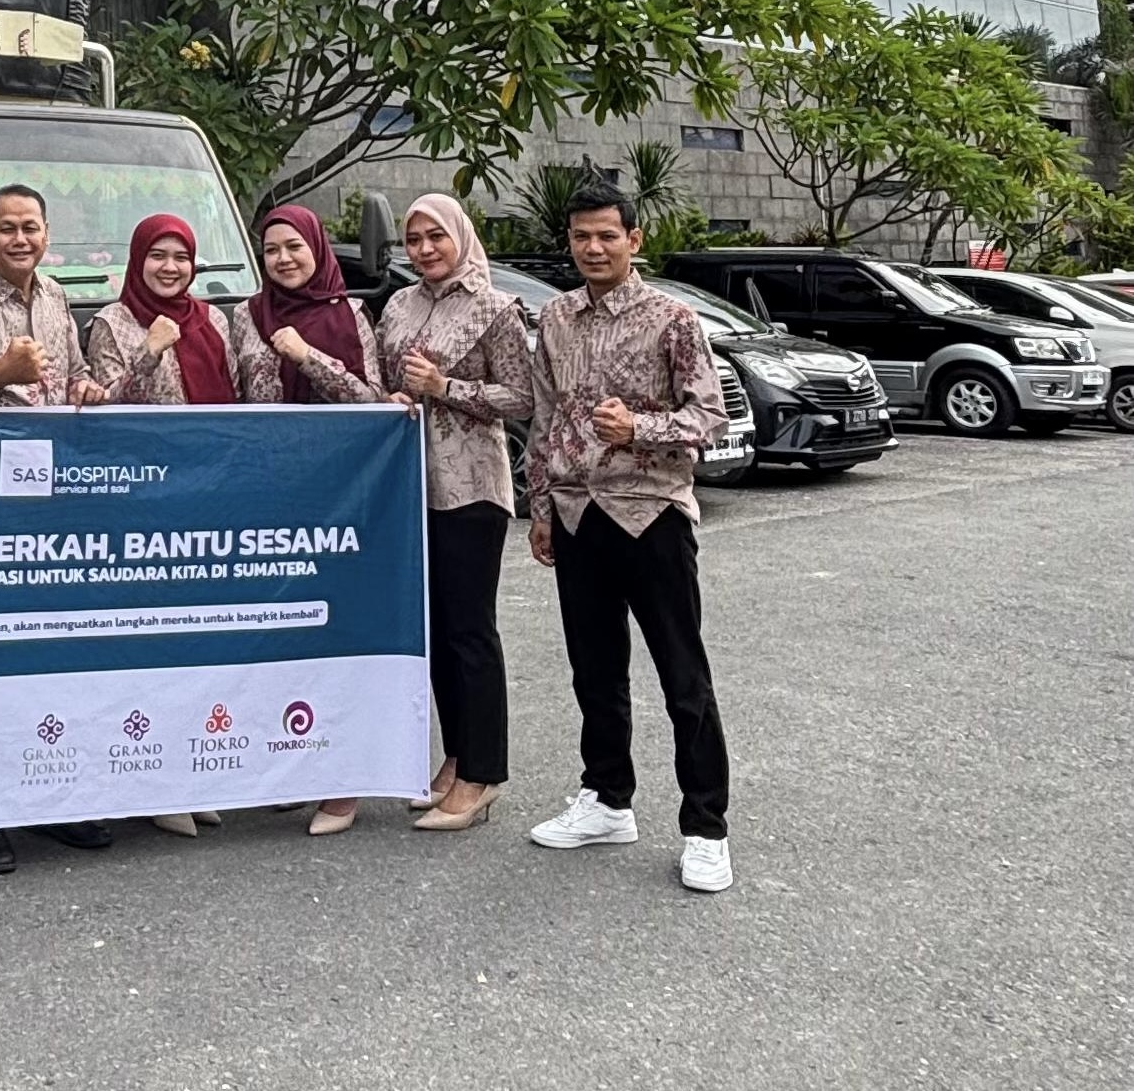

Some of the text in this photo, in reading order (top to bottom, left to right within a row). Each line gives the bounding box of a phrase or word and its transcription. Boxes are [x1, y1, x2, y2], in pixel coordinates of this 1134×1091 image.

[12, 465, 169, 483] SAS HOSPITALITY
[54, 484, 130, 494] service and soul
[123, 530, 233, 560] BANTU
[239, 526, 360, 556] SESAMA
[26, 567, 85, 585] UNTUK
[88, 566, 168, 582] SAUDARA
[171, 564, 208, 579] KITA
[210, 563, 228, 579] DI
[233, 561, 318, 578] SUMATERA
[13, 621, 41, 631] akan
[43, 618, 113, 631] menguatkan
[115, 616, 159, 629] langkah
[161, 613, 201, 625] mereka
[203, 612, 234, 623] untuk
[237, 610, 278, 623] bangkit
[22, 746, 77, 761] GRAND
[109, 743, 163, 758] GRAND
[187, 736, 250, 756] TJOKRO
[22, 761, 77, 777] TJOKRO
[108, 758, 163, 775] TJOKRO
[192, 756, 244, 773] HOTEL
